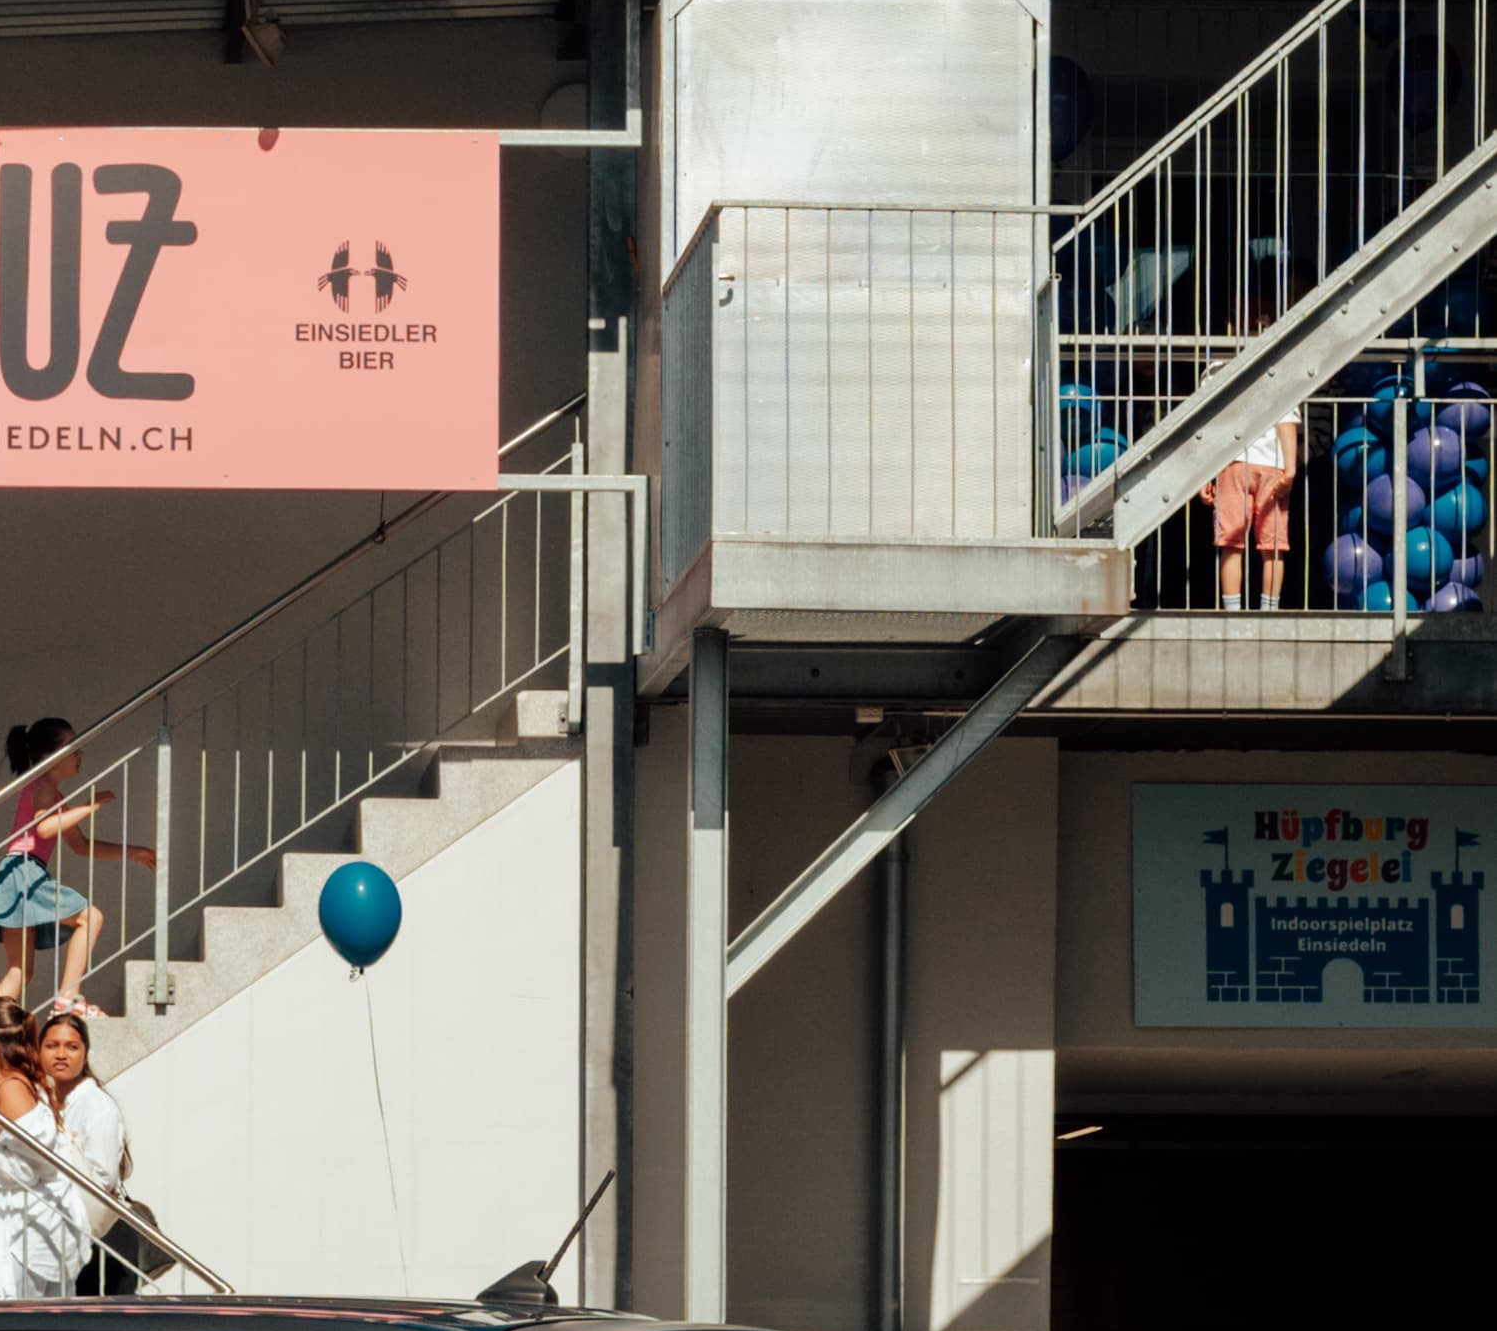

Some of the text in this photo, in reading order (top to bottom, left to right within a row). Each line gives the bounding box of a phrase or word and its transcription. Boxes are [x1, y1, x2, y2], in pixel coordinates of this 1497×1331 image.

[295, 323, 437, 343] EINSIEDLER
[339, 351, 395, 370] BIER
[1254, 808, 1429, 851] Hüpfburg
[1271, 850, 1413, 891] Ziegelei
[1271, 917, 1414, 935] Indoorspielplatz
[1298, 937, 1387, 952] Einsiedeln
